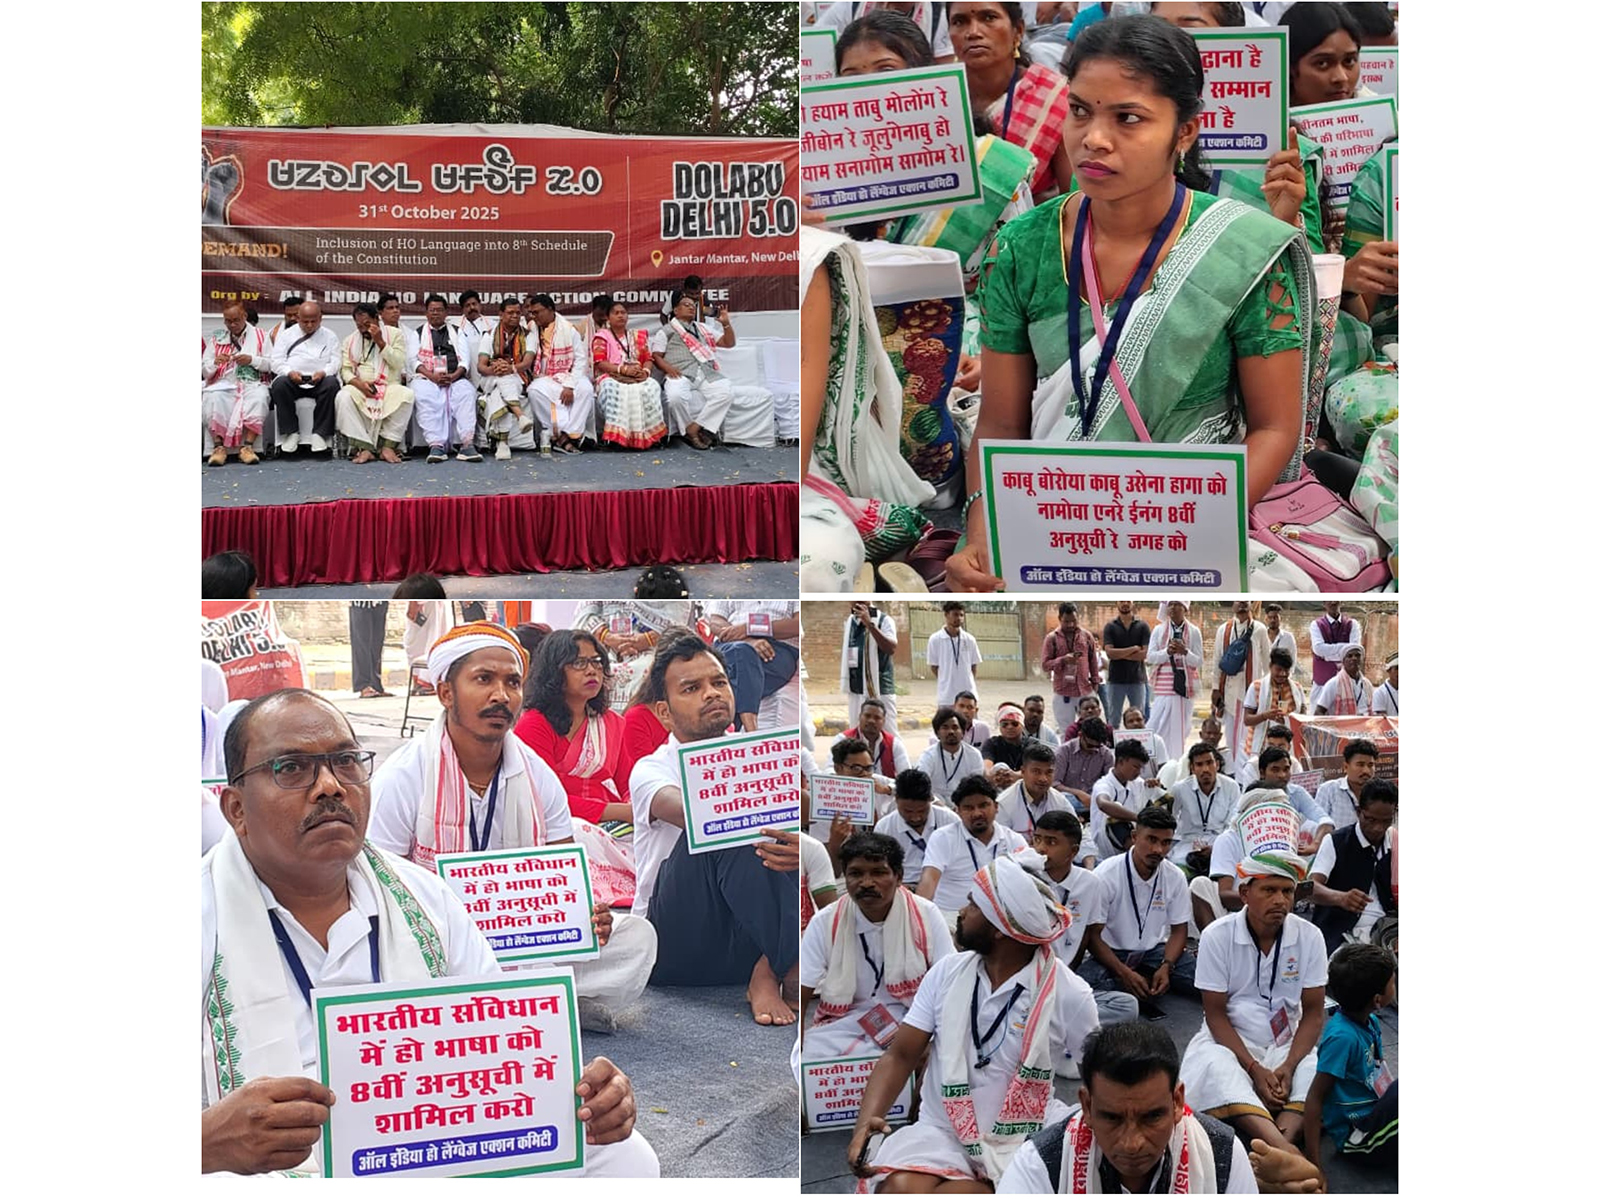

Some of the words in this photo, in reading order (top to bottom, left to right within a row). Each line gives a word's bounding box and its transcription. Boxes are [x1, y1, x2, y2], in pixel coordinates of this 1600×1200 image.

[1199, 50, 1244, 73] ढ़ाना
[1245, 44, 1263, 68] है
[1210, 81, 1273, 98] सम्मान
[811, 102, 848, 122] हयाम
[852, 99, 883, 121] ताबु
[885, 88, 936, 113] मोलोंग
[936, 86, 948, 107] रे
[1198, 112, 1217, 128] ना
[1219, 105, 1236, 128] है
[1301, 117, 1333, 130] चीनतम
[844, 127, 857, 148] रे
[860, 122, 933, 152] जूलुगेनाबु
[934, 116, 951, 137] हो
[1207, 138, 1234, 149] एक्शन
[1235, 135, 1263, 149] कमिटी
[801, 164, 830, 183] याम
[834, 153, 894, 178] सनागोम
[898, 145, 946, 171] सागोम
[672, 161, 785, 200] DOLABU
[858, 187, 868, 201] हो
[359, 204, 388, 218] 31st
[391, 204, 457, 220] October
[460, 206, 499, 220] 2025
[660, 199, 745, 240] DELHI
[747, 197, 797, 236] 5.0
[202, 241, 288, 259] EMAND!
[316, 238, 378, 249] Inclusion
[381, 238, 394, 249] of
[397, 239, 416, 250] HO
[420, 239, 481, 252] Language
[484, 240, 510, 251] into
[512, 240, 528, 251] 8th
[531, 240, 588, 251] Schedule
[316, 254, 330, 265] of
[332, 254, 352, 265] the
[357, 254, 437, 266] Constitution
[668, 254, 705, 265] Jantar
[706, 253, 749, 264] Mantar,
[751, 252, 776, 262] New
[210, 290, 237, 301] Org
[241, 291, 260, 301] by
[324, 290, 381, 304] INDIA
[1002, 472, 1037, 496] काबू
[1037, 467, 1085, 491] बोरोया
[1088, 474, 1123, 499] काबू
[1125, 470, 1165, 493] उसेना
[1169, 477, 1203, 495] हागा
[1206, 472, 1227, 495] को
[1037, 498, 1089, 520] नामोवा
[1093, 500, 1124, 521] एनरे
[1128, 500, 1162, 524] ईनंग
[1168, 502, 1196, 523] 8वीं
[1049, 528, 1106, 554] अनुसूची
[1106, 528, 1119, 549] रे
[1127, 534, 1165, 550] जगह
[1167, 530, 1188, 551] को
[1026, 567, 1053, 581] ऑल
[1055, 568, 1087, 582] इंडिया
[1089, 569, 1102, 582] हो
[1104, 569, 1140, 583] लैंग्वेज
[1142, 572, 1178, 584] एक्शन
[1179, 571, 1216, 584] कमिटी
[689, 748, 746, 767] भारतीय
[751, 740, 799, 757] संविधा
[702, 766, 717, 781] में
[720, 764, 736, 779] हो
[742, 759, 779, 775] भाषा
[699, 782, 728, 800] 8वीं
[733, 772, 794, 794] अनुसूची
[714, 795, 768, 815] शामिल
[450, 862, 508, 879] भारतीय
[513, 857, 577, 874] संविधान
[464, 880, 478, 896] में
[483, 879, 500, 895] हो
[505, 877, 543, 892] भाषा
[546, 873, 568, 888] को
[497, 892, 560, 913] अनुसूची
[563, 888, 578, 903] में
[475, 914, 533, 931] शामिल
[536, 909, 567, 925] करो
[336, 1004, 443, 1035] भारतीय
[451, 995, 560, 1024] संविधान
[359, 1038, 387, 1067] में
[393, 1037, 425, 1064] हो
[433, 1034, 500, 1058] भाषा
[505, 1025, 544, 1051] को
[350, 1071, 407, 1103] 8वीं
[415, 1060, 525, 1098] अनुसूची
[532, 1055, 559, 1081] में
[809, 1064, 855, 1076] भारतीय
[819, 1075, 830, 1087] में
[833, 1074, 846, 1086] हो
[815, 1086, 839, 1099] 8वीं
[842, 1087, 865, 1098] अनु
[825, 1097, 861, 1109] शामि
[375, 1104, 477, 1135] शामिल
[482, 1092, 536, 1119] करो
[359, 1150, 387, 1171] ऑल
[390, 1146, 423, 1168] इंडिया
[426, 1145, 439, 1163] हो
[442, 1140, 478, 1160] लैंग्वेज
[480, 1135, 516, 1155] एक्शन
[517, 1129, 552, 1150] कमिटी
